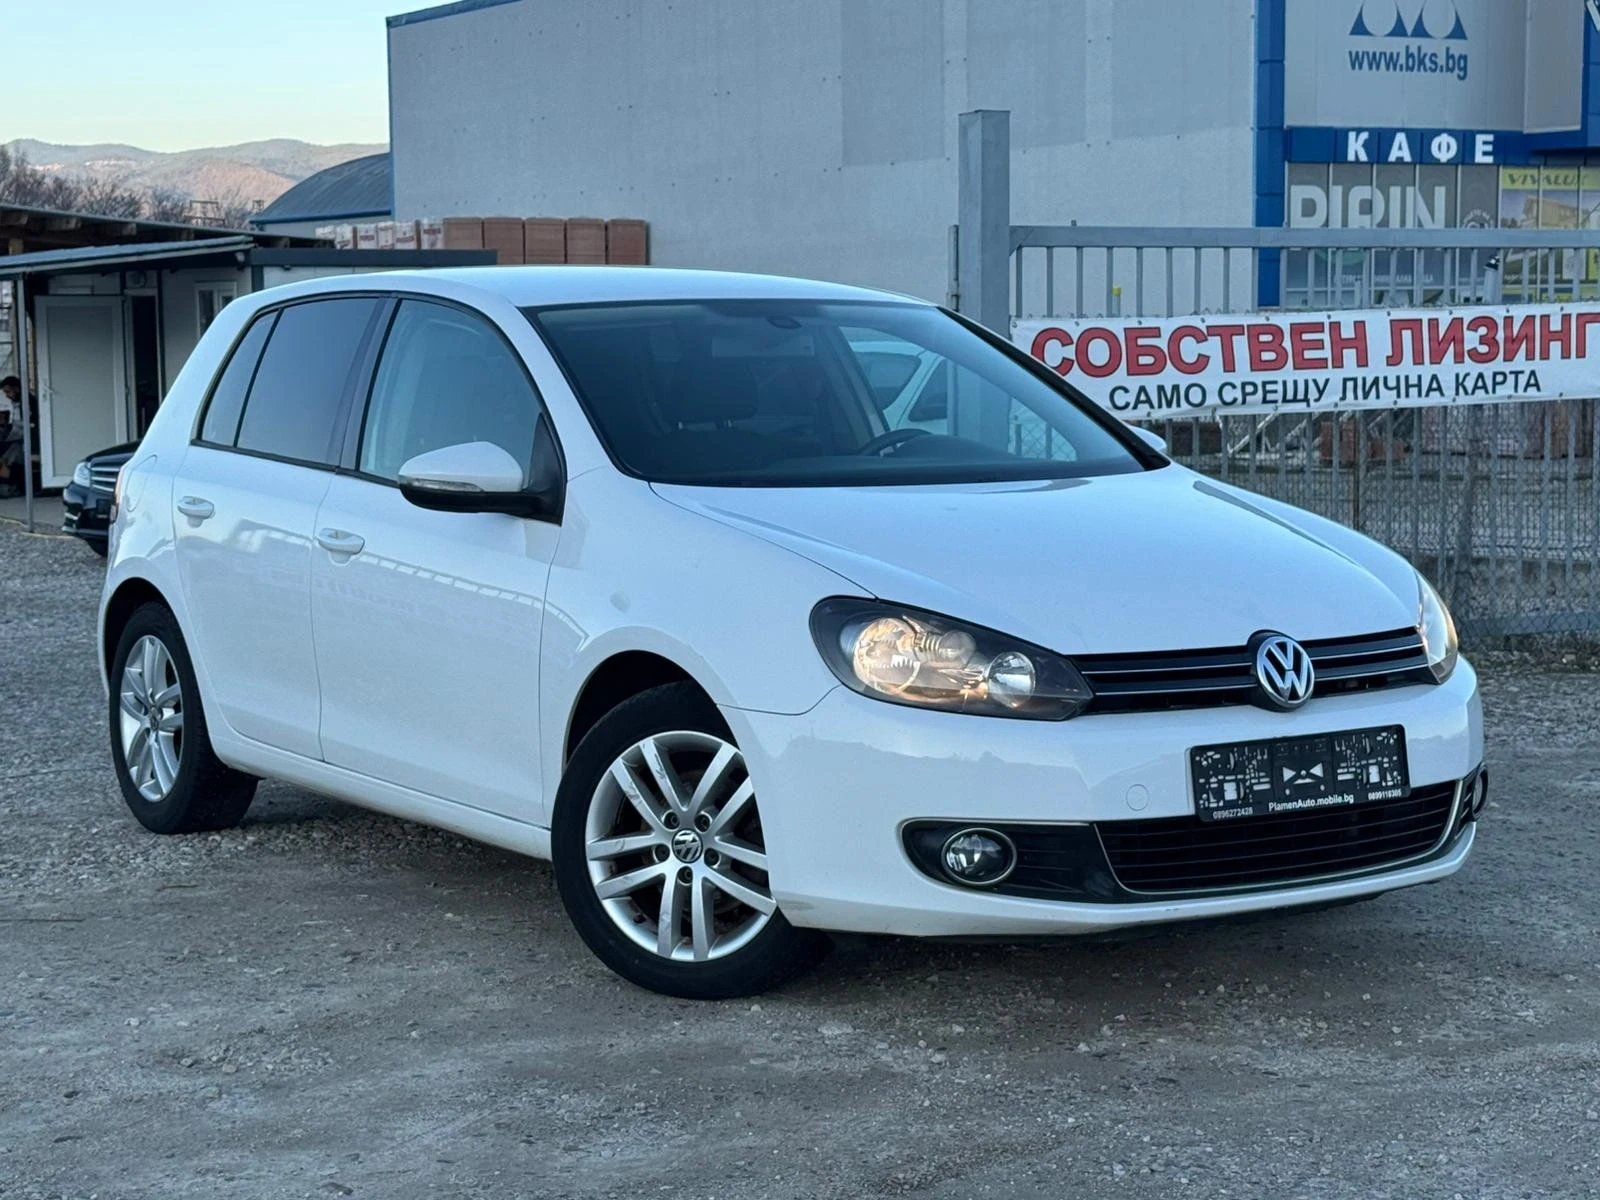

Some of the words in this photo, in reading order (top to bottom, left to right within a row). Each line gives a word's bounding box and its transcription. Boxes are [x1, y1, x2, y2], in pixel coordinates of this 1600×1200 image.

[1348, 45, 1468, 81] www.bks.bg
[1030, 320, 1369, 378] СОБСТВЕН
[1386, 313, 1600, 367] ЛИЗИНГ
[1109, 382, 1207, 411] САМО
[1217, 377, 1330, 408] СРЕЩУ
[1339, 373, 1445, 401] ЛИЧНА
[1454, 369, 1542, 396] КАРТА
